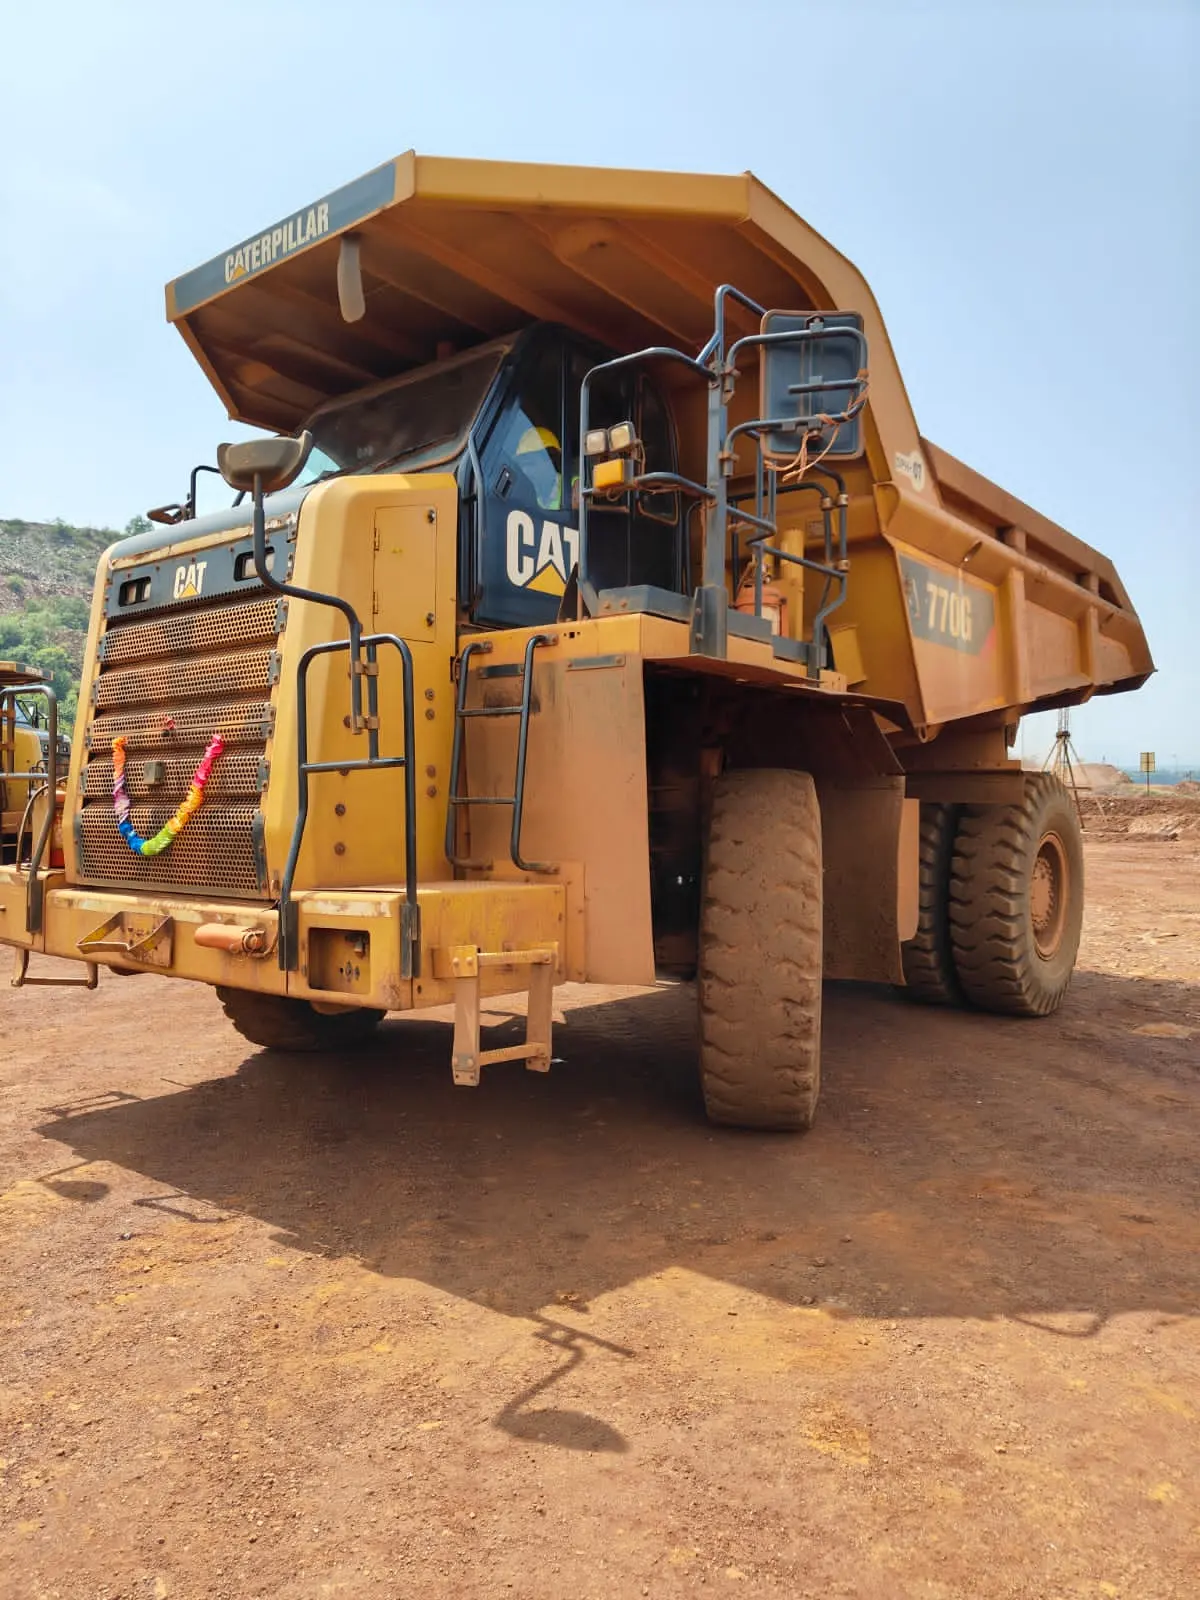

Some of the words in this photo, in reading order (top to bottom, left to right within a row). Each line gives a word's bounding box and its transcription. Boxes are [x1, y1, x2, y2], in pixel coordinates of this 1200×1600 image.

[225, 203, 328, 283] CATERPILLAR
[173, 562, 207, 600] CAT
[507, 510, 579, 588] CAT
[926, 583, 972, 642] 770G
